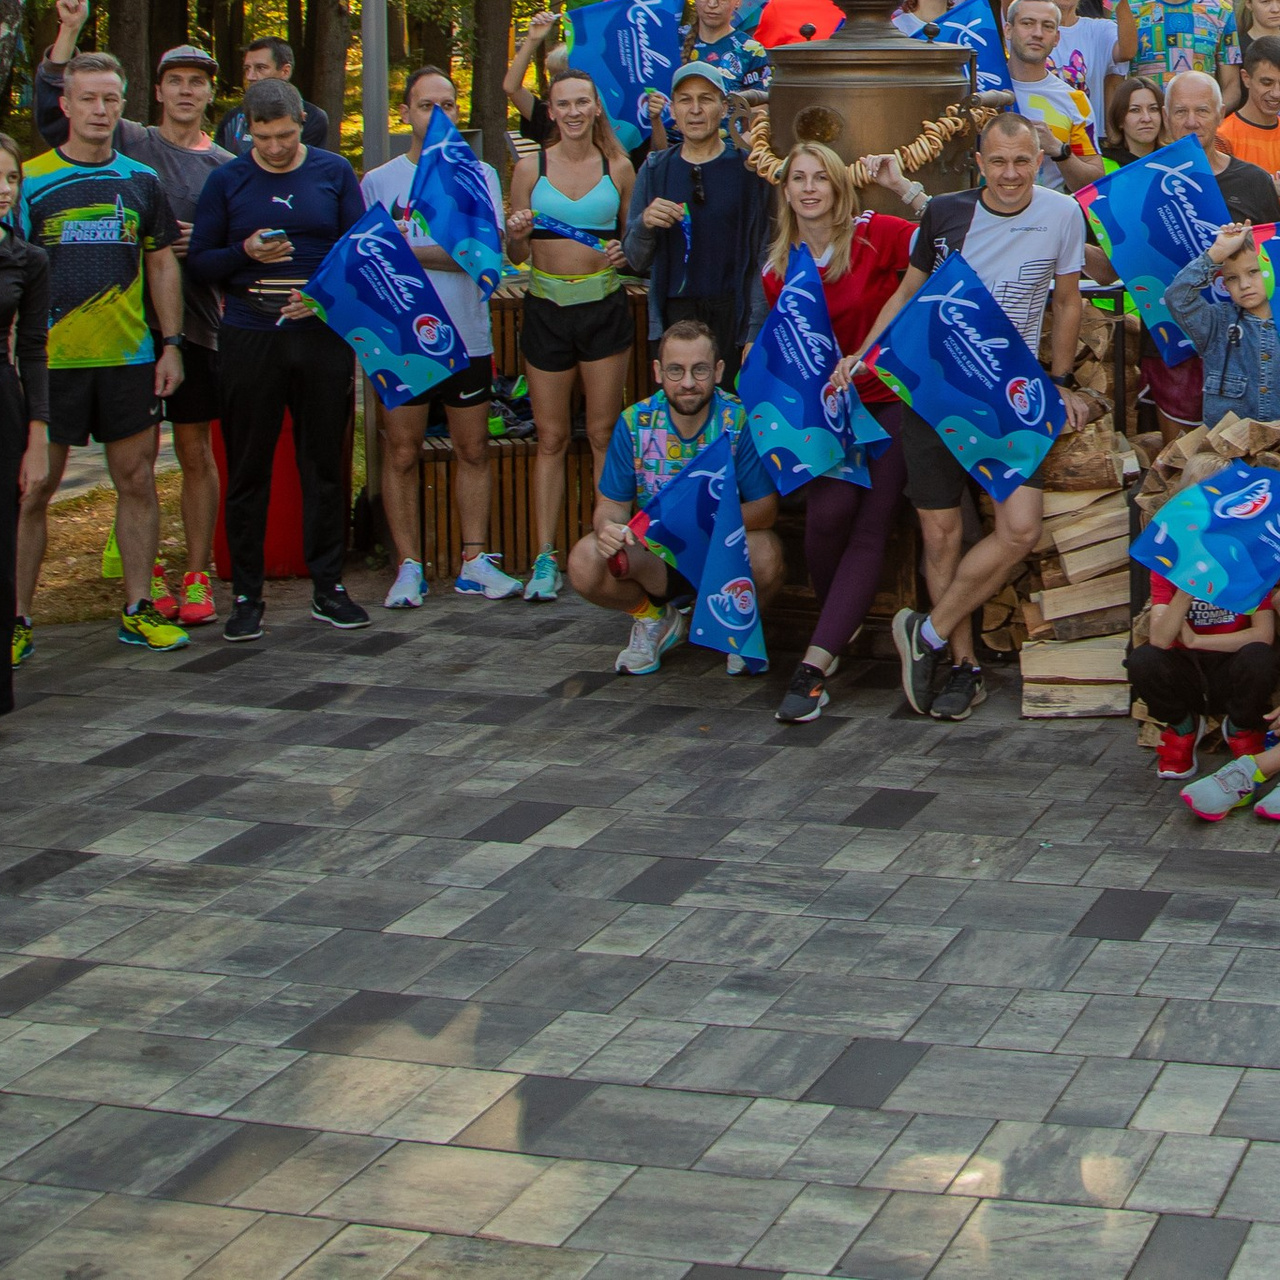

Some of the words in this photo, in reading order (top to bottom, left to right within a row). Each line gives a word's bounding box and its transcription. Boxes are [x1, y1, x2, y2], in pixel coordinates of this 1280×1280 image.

[63, 221, 122, 230] ГАТЧИНСКИЕ
[1157, 207, 1182, 246] ПОКОЛЕНИЙ
[1163, 204, 1177, 224] УСПЕХ
[61, 230, 120, 242] ПРОБЕЖКИ
[772, 328, 793, 364] ПОКОЛЕНИЙ
[778, 323, 788, 343] УСПЕХ
[788, 347, 810, 380] ЕДИНСТВЕ
[943, 340, 973, 378] ПОКОЛЕНИЙ
[947, 335, 964, 357] УСПЕХ
[966, 360, 994, 390] ЕДИНСТВЕ
[1194, 615, 1235, 626] HILFIGER
